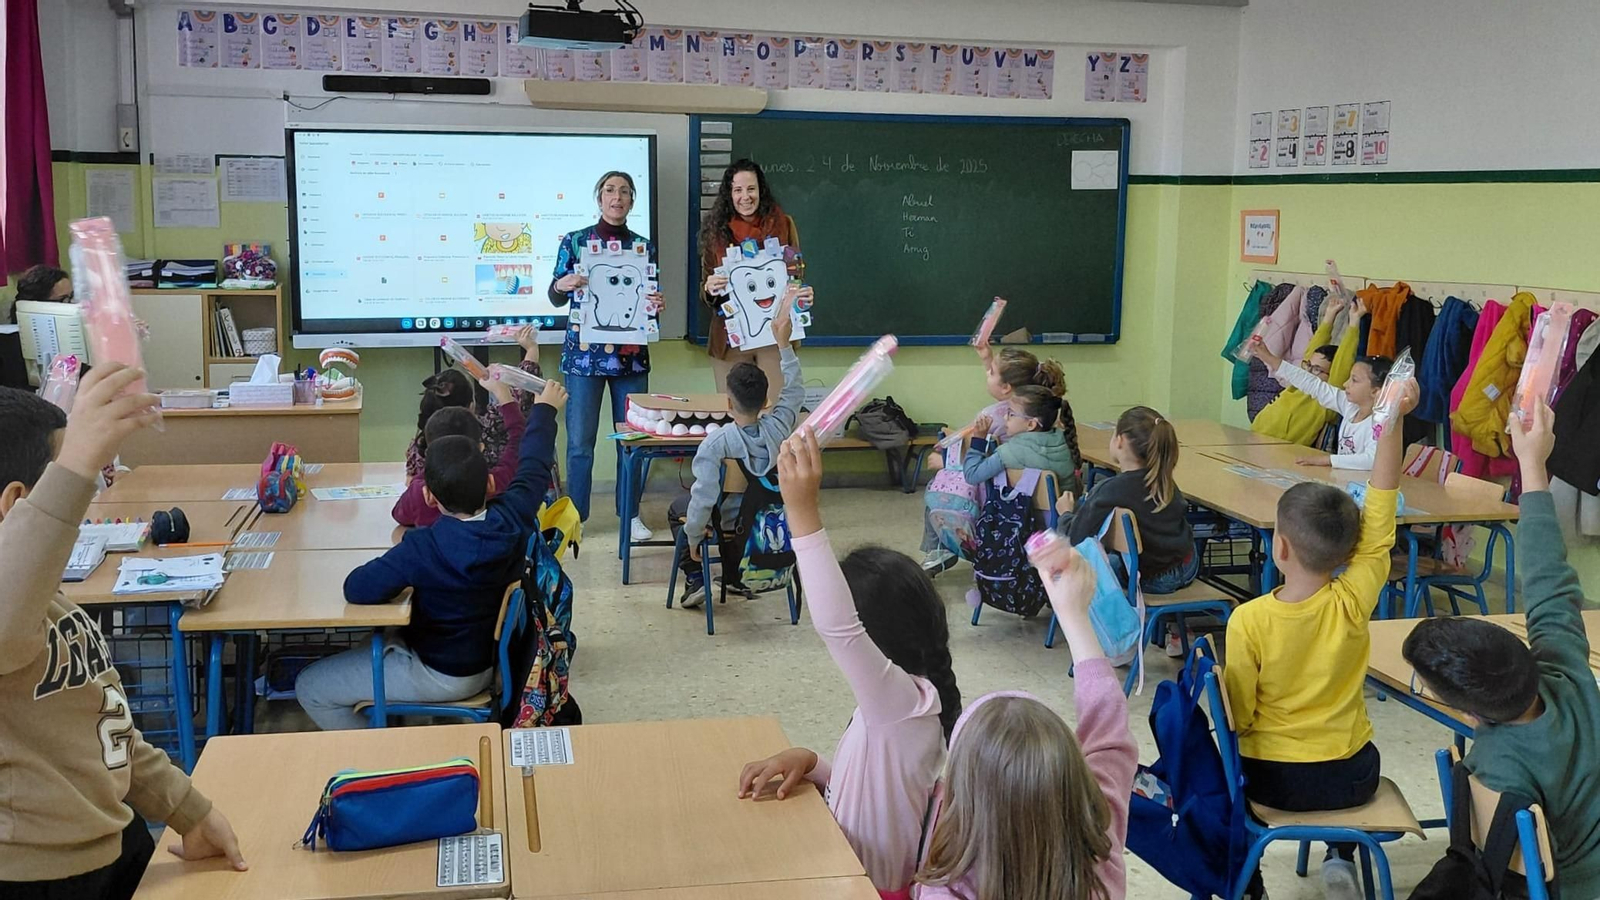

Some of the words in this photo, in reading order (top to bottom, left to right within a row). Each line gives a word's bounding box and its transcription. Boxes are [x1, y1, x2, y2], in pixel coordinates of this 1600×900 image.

[178, 12, 193, 31] A
[223, 14, 238, 33] B
[263, 15, 277, 35] C
[307, 17, 321, 36] D
[346, 18, 356, 38] E
[424, 21, 438, 41] G
[464, 24, 476, 42] H
[650, 35, 665, 51] M
[687, 35, 700, 53] N
[757, 42, 770, 60] O
[795, 40, 807, 58] P
[826, 40, 839, 59] Q
[862, 43, 874, 61] R
[895, 45, 906, 62] S
[930, 46, 941, 63] T
[962, 48, 974, 65] U
[994, 51, 1007, 68] V
[1024, 53, 1038, 67] W
[1087, 55, 1100, 72] Y
[1120, 57, 1131, 73] Z
[1290, 115, 1298, 132] 3
[1347, 110, 1357, 127] 7
[1260, 145, 1268, 161] 2
[1288, 143, 1296, 159] 4
[1316, 140, 1324, 156] 6
[1345, 140, 1355, 158] 8
[1374, 140, 1387, 155] 10
[841, 154, 855, 172] de
[936, 156, 949, 172] de
[960, 159, 988, 174] 2025
[97, 684, 134, 770] 2
